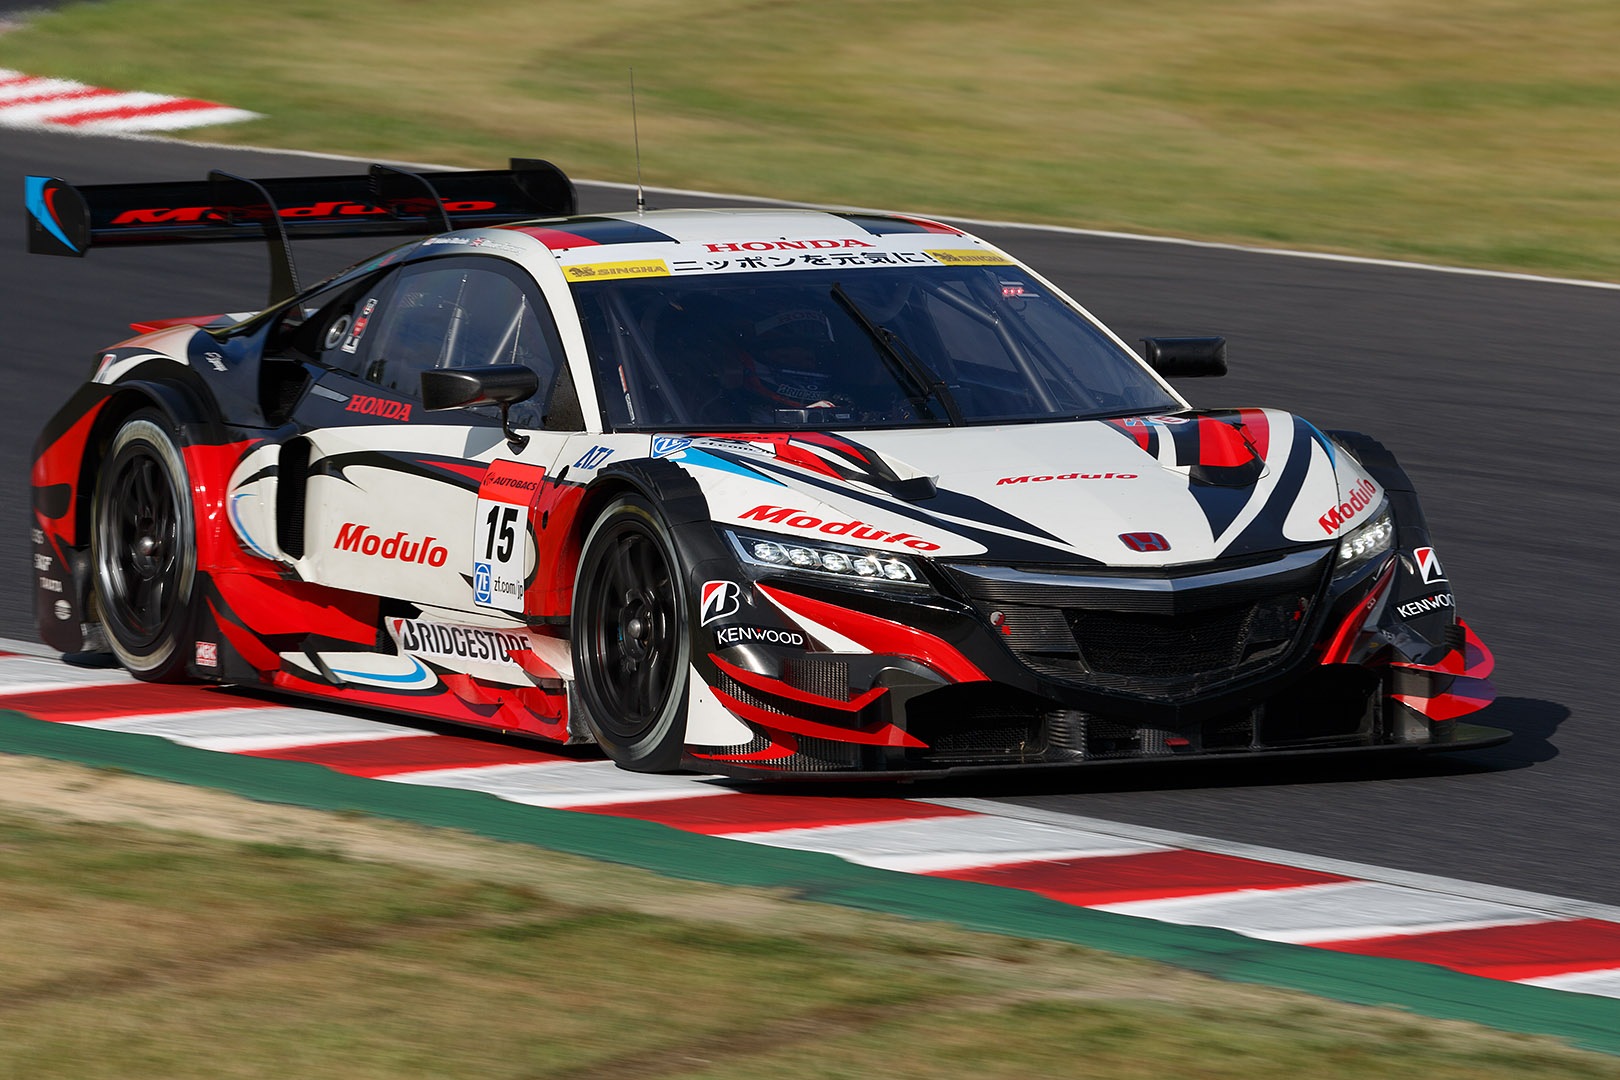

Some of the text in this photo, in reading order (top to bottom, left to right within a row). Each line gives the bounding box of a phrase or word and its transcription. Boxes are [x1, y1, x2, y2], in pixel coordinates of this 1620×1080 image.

[701, 239, 877, 253] HONDA
[597, 265, 666, 277] SINGHA
[345, 394, 412, 421] HONDA
[493, 476, 537, 491] AUTOBACS
[996, 473, 1138, 486] Modulo
[1318, 478, 1377, 535] Modulo
[486, 505, 519, 563] 15
[737, 505, 941, 551] Modulo
[333, 522, 448, 568] Modulo
[716, 627, 804, 646] KENWOOD
